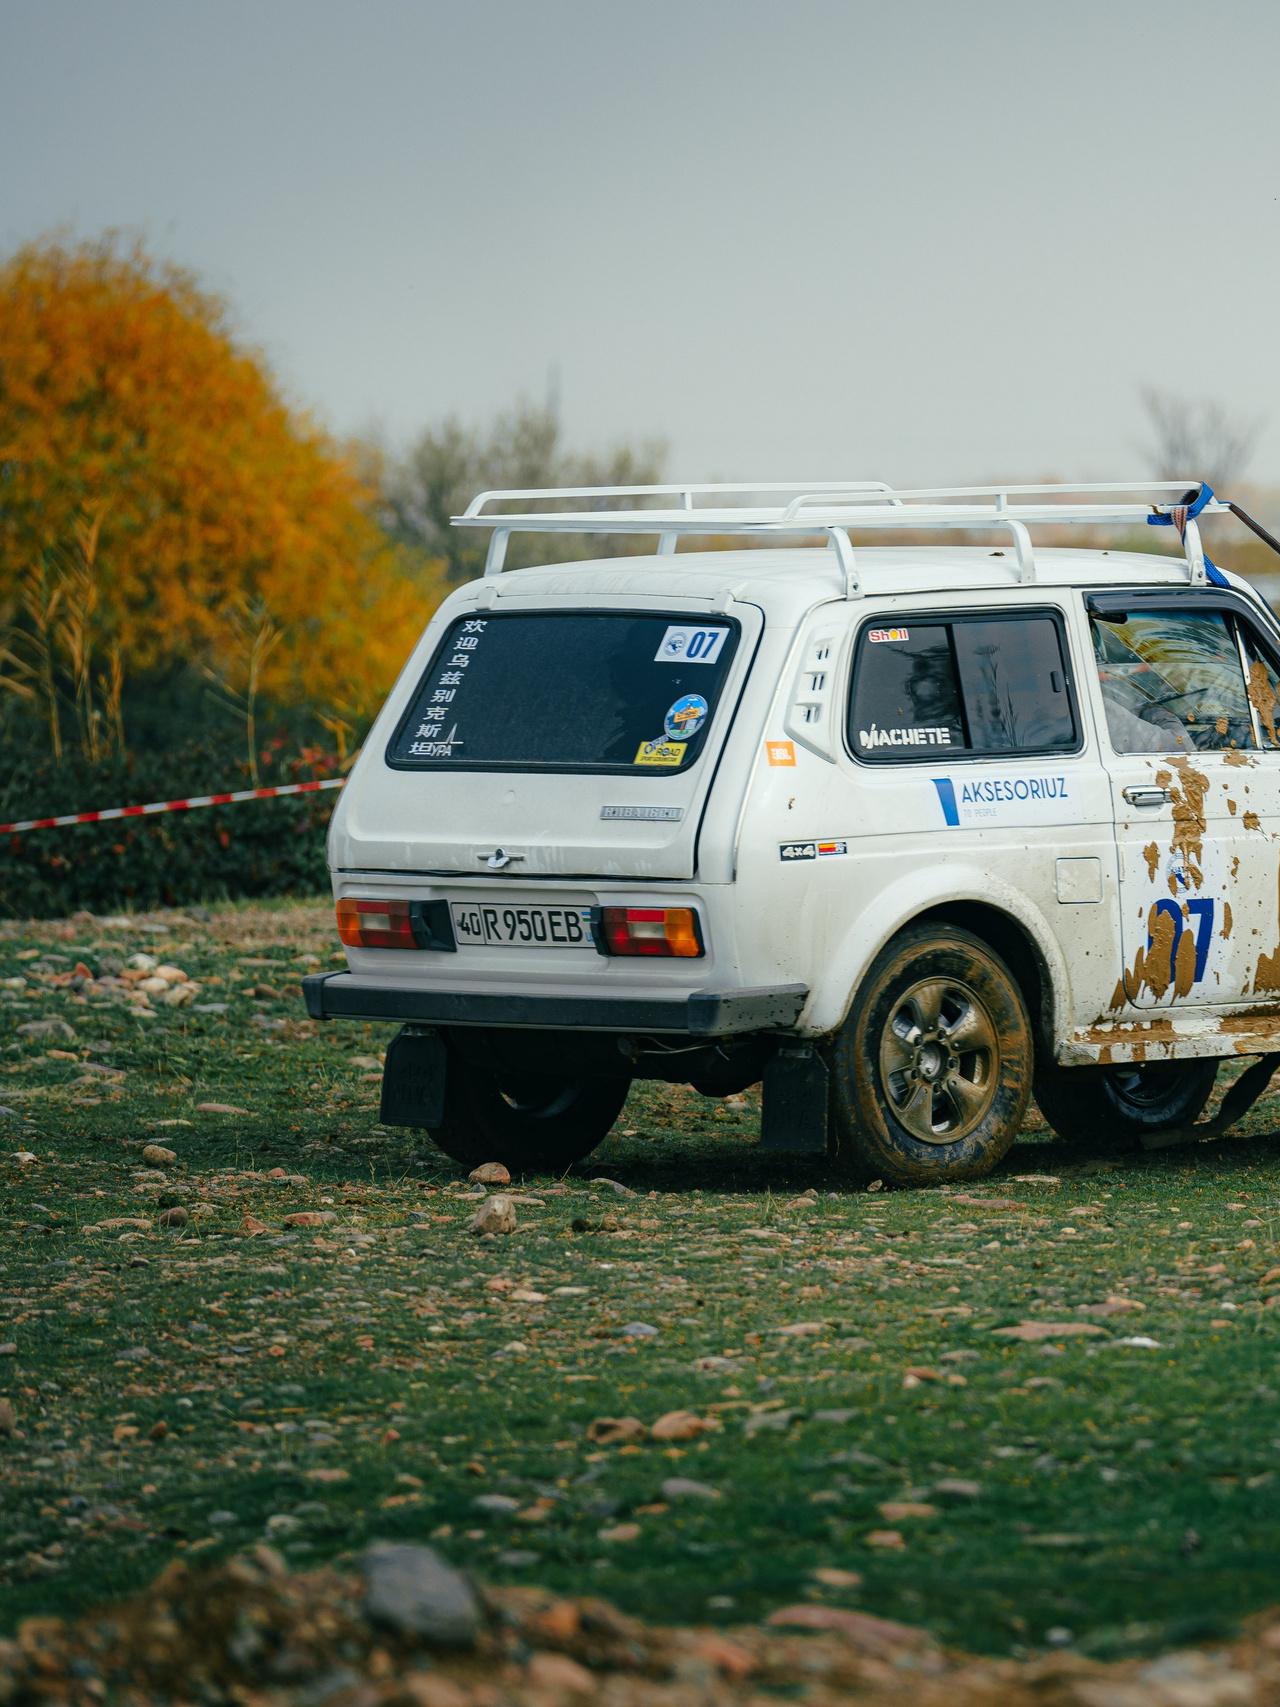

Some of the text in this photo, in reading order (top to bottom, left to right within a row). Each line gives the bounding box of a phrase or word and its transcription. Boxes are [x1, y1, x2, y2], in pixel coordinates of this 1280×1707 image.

[686, 631, 719, 658] 07
[870, 630, 907, 641] Shll
[408, 619, 487, 756] 欢迎乌兹别克斯坦
[770, 748, 792, 760] JBL
[962, 777, 1068, 803] AKSESORIUZ
[459, 912, 481, 936] 40
